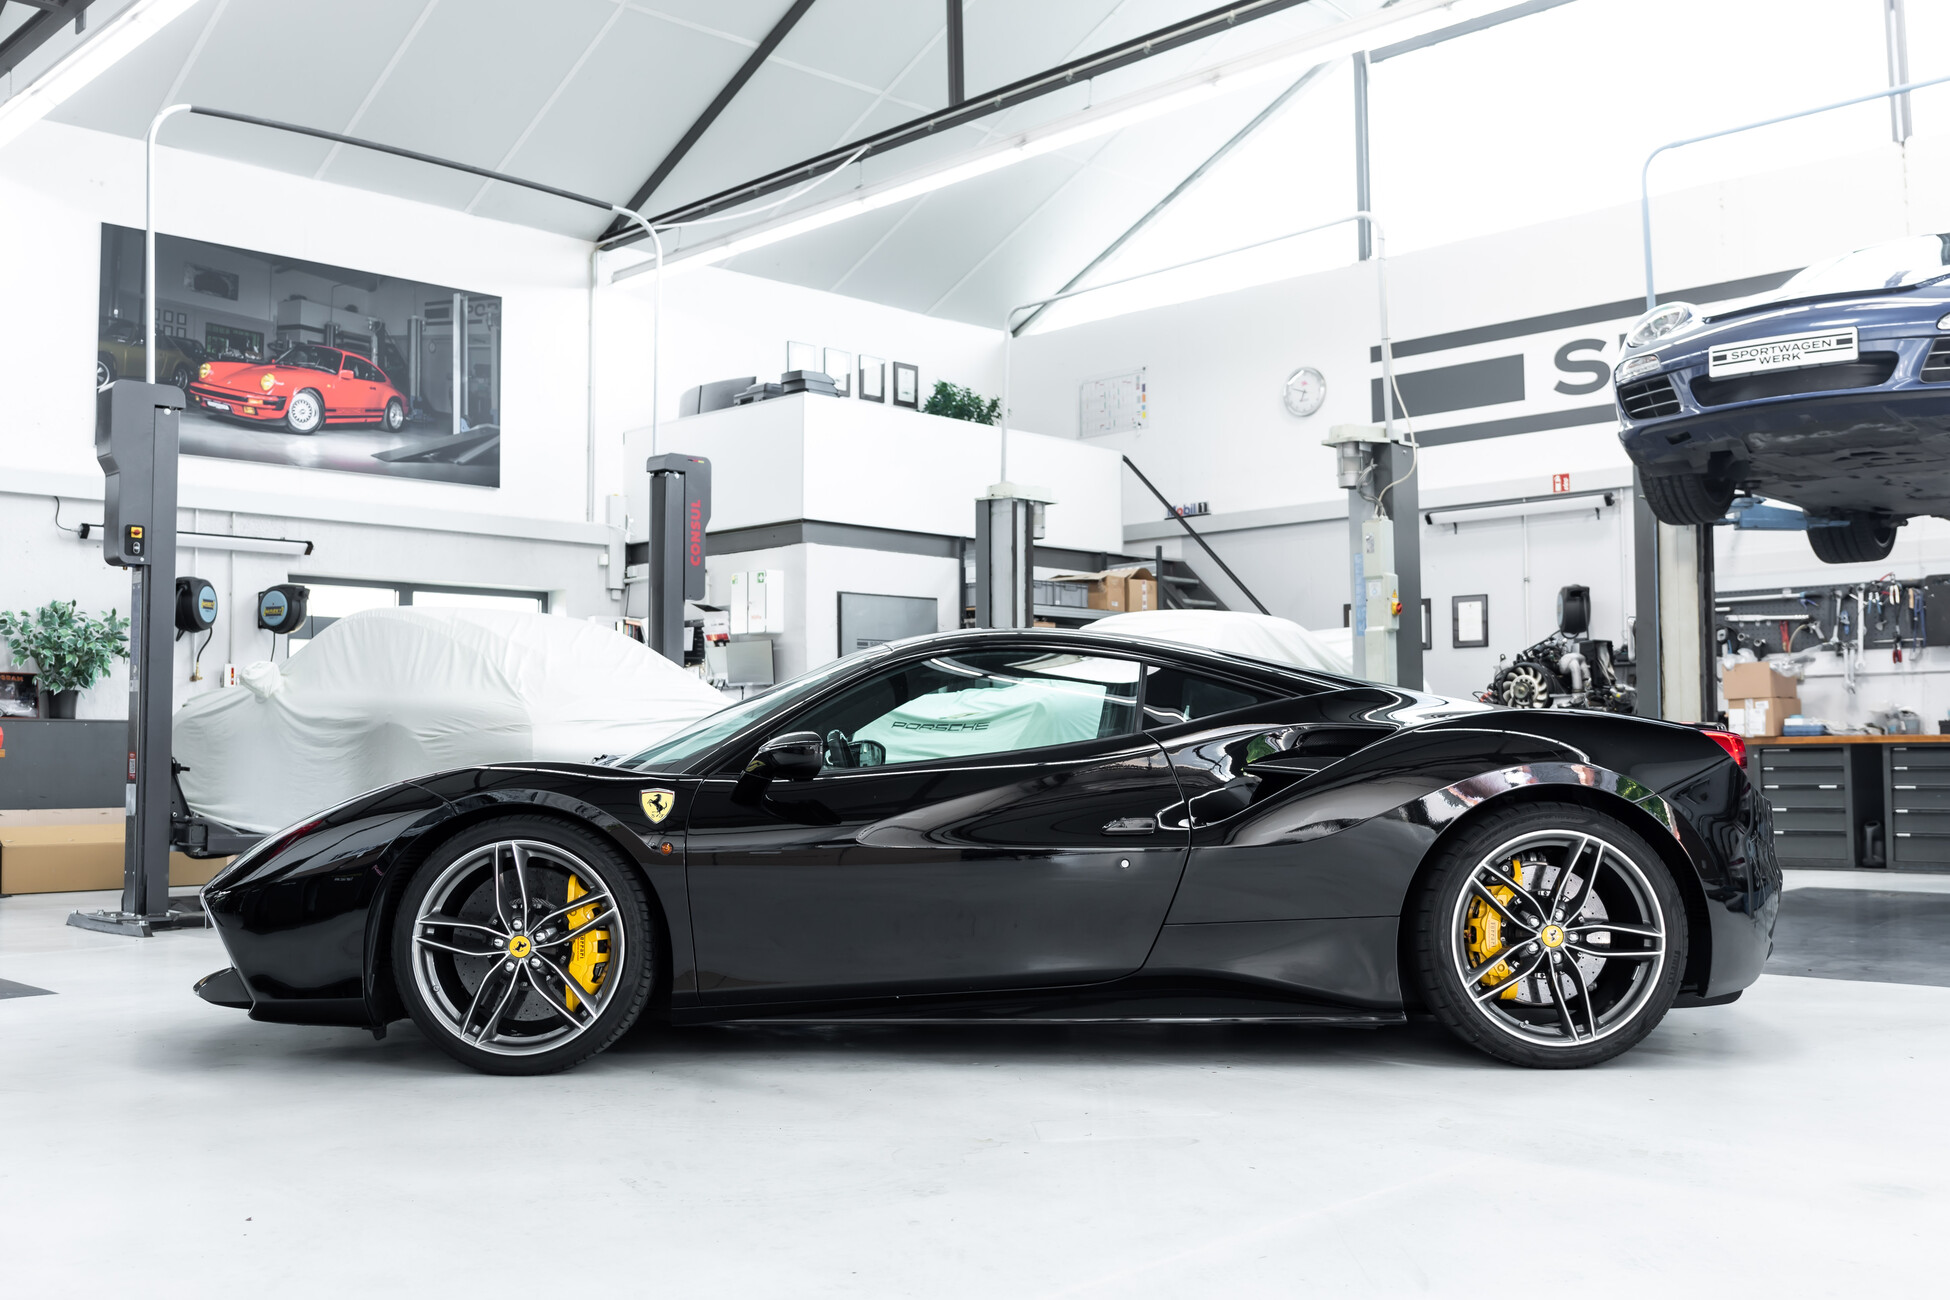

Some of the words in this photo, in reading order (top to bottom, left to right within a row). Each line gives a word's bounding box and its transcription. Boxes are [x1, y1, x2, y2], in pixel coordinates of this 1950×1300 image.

[1731, 339, 1831, 360] SPORTWAGEN
[1759, 352, 1801, 365] WERK
[1554, 333, 1628, 396] S
[690, 499, 701, 567] CONSUL
[891, 721, 990, 732] PORSCHE
